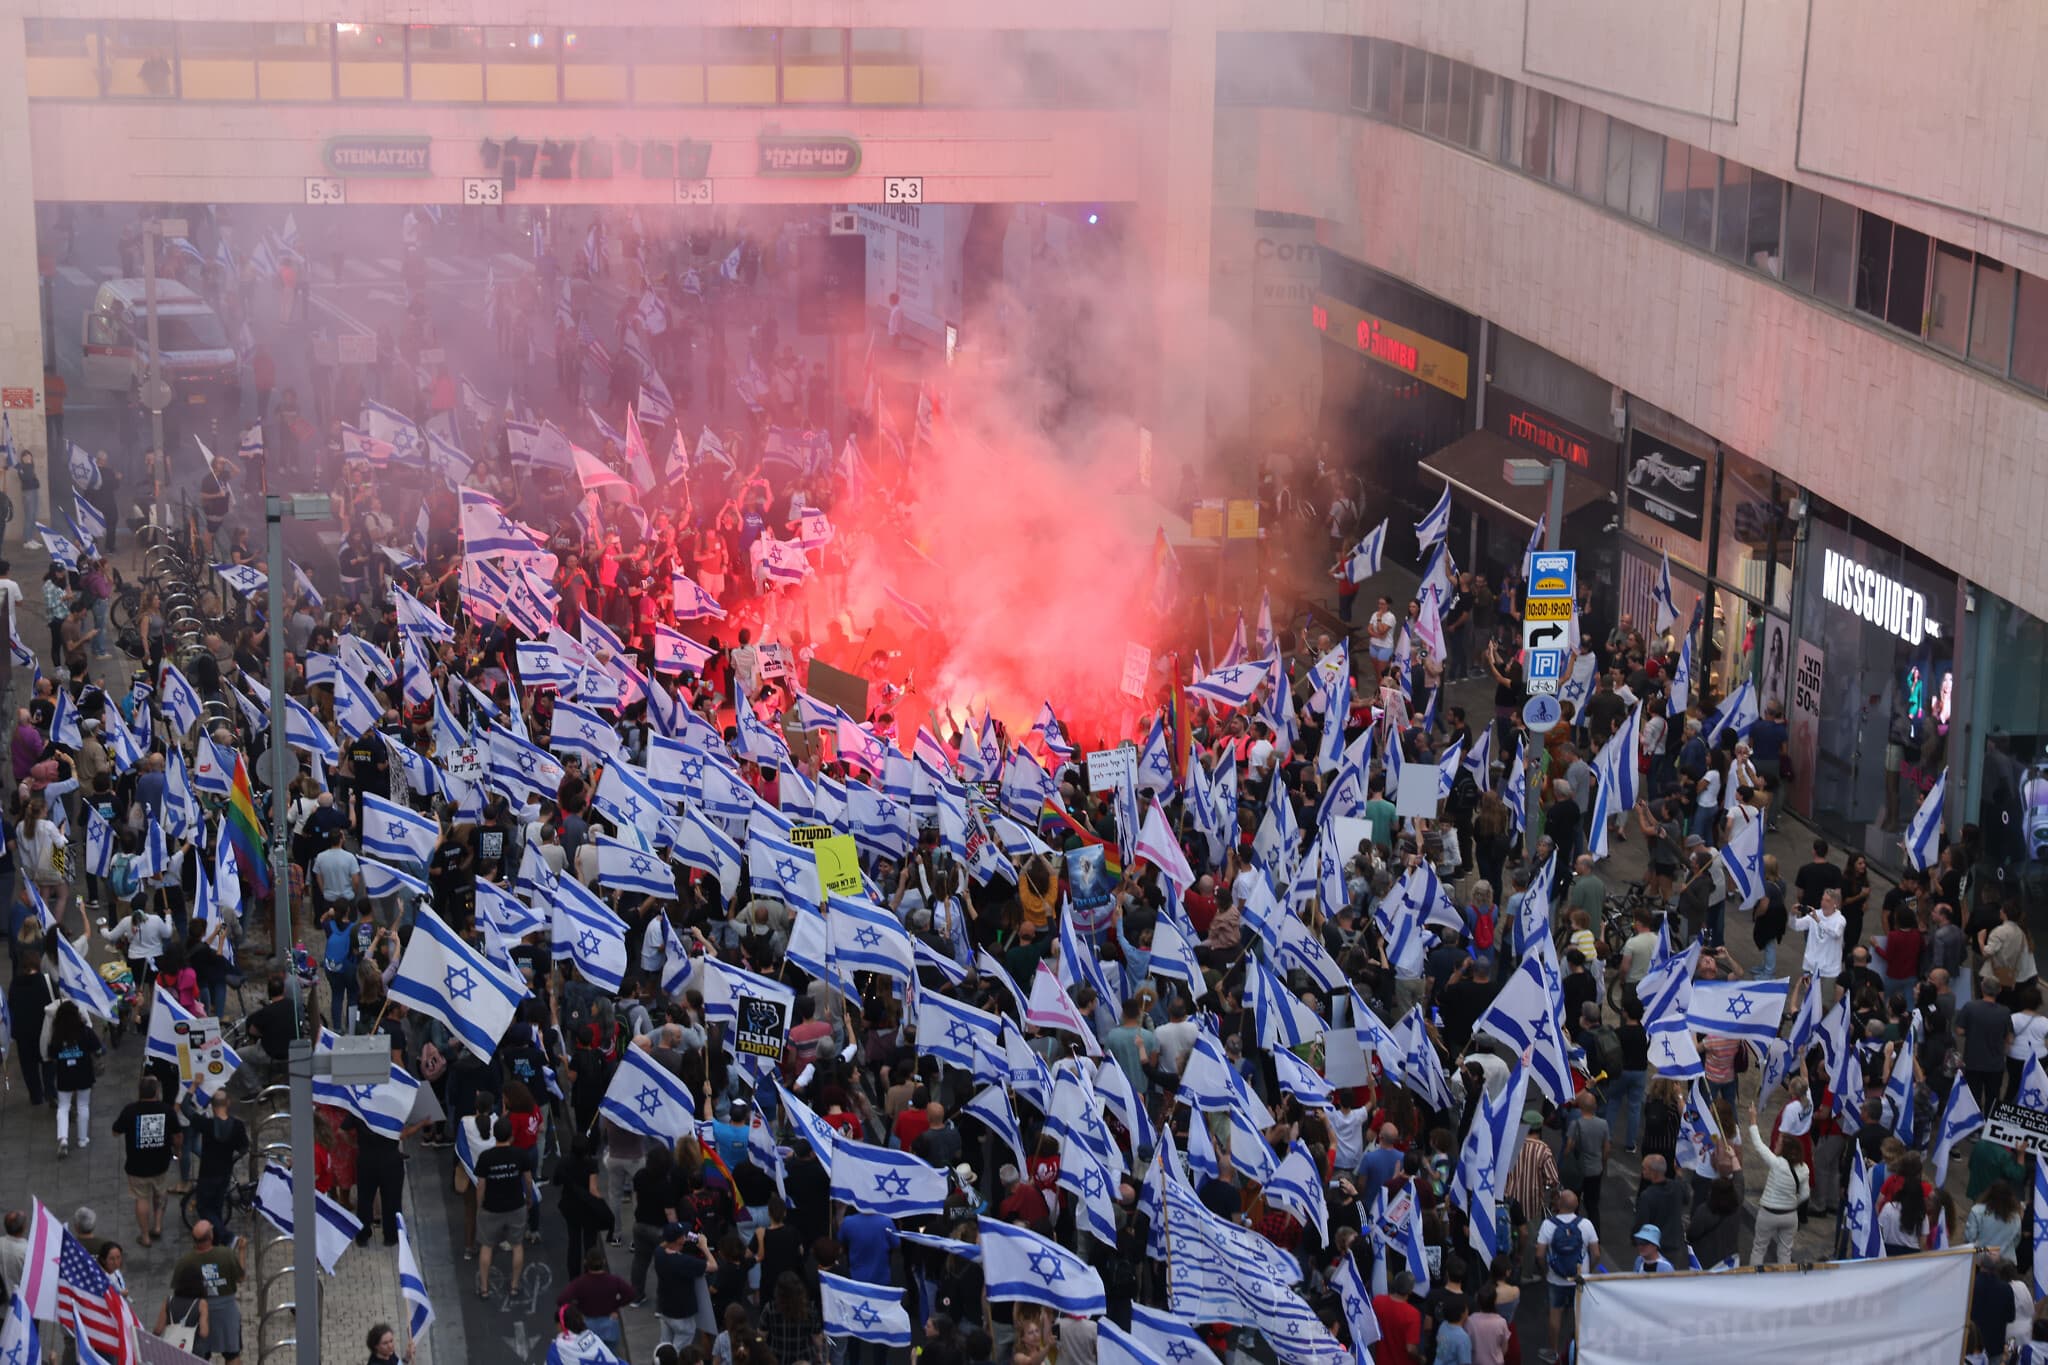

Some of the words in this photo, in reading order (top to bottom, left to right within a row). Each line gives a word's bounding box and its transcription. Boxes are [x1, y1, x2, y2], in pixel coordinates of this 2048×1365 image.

[335, 148, 426, 165] STEIMATZKY
[766, 148, 849, 168] סטימצקי
[311, 184, 342, 200] 5.3
[468, 184, 500, 200] 5.3
[680, 184, 710, 200] 5.3
[889, 183, 919, 199] 5.3
[1823, 548, 1924, 646] MISSGUIDED
[1924, 617, 1943, 639] UK
[1528, 602, 1571, 616] 10:00-19:00
[1803, 655, 1821, 677] חצי
[1797, 668, 1820, 693] חנות
[1794, 687, 1819, 718] 50%
[792, 827, 832, 841] ממשלת
[739, 1031, 781, 1049] חובה
[740, 1040, 780, 1058] להתנגד
